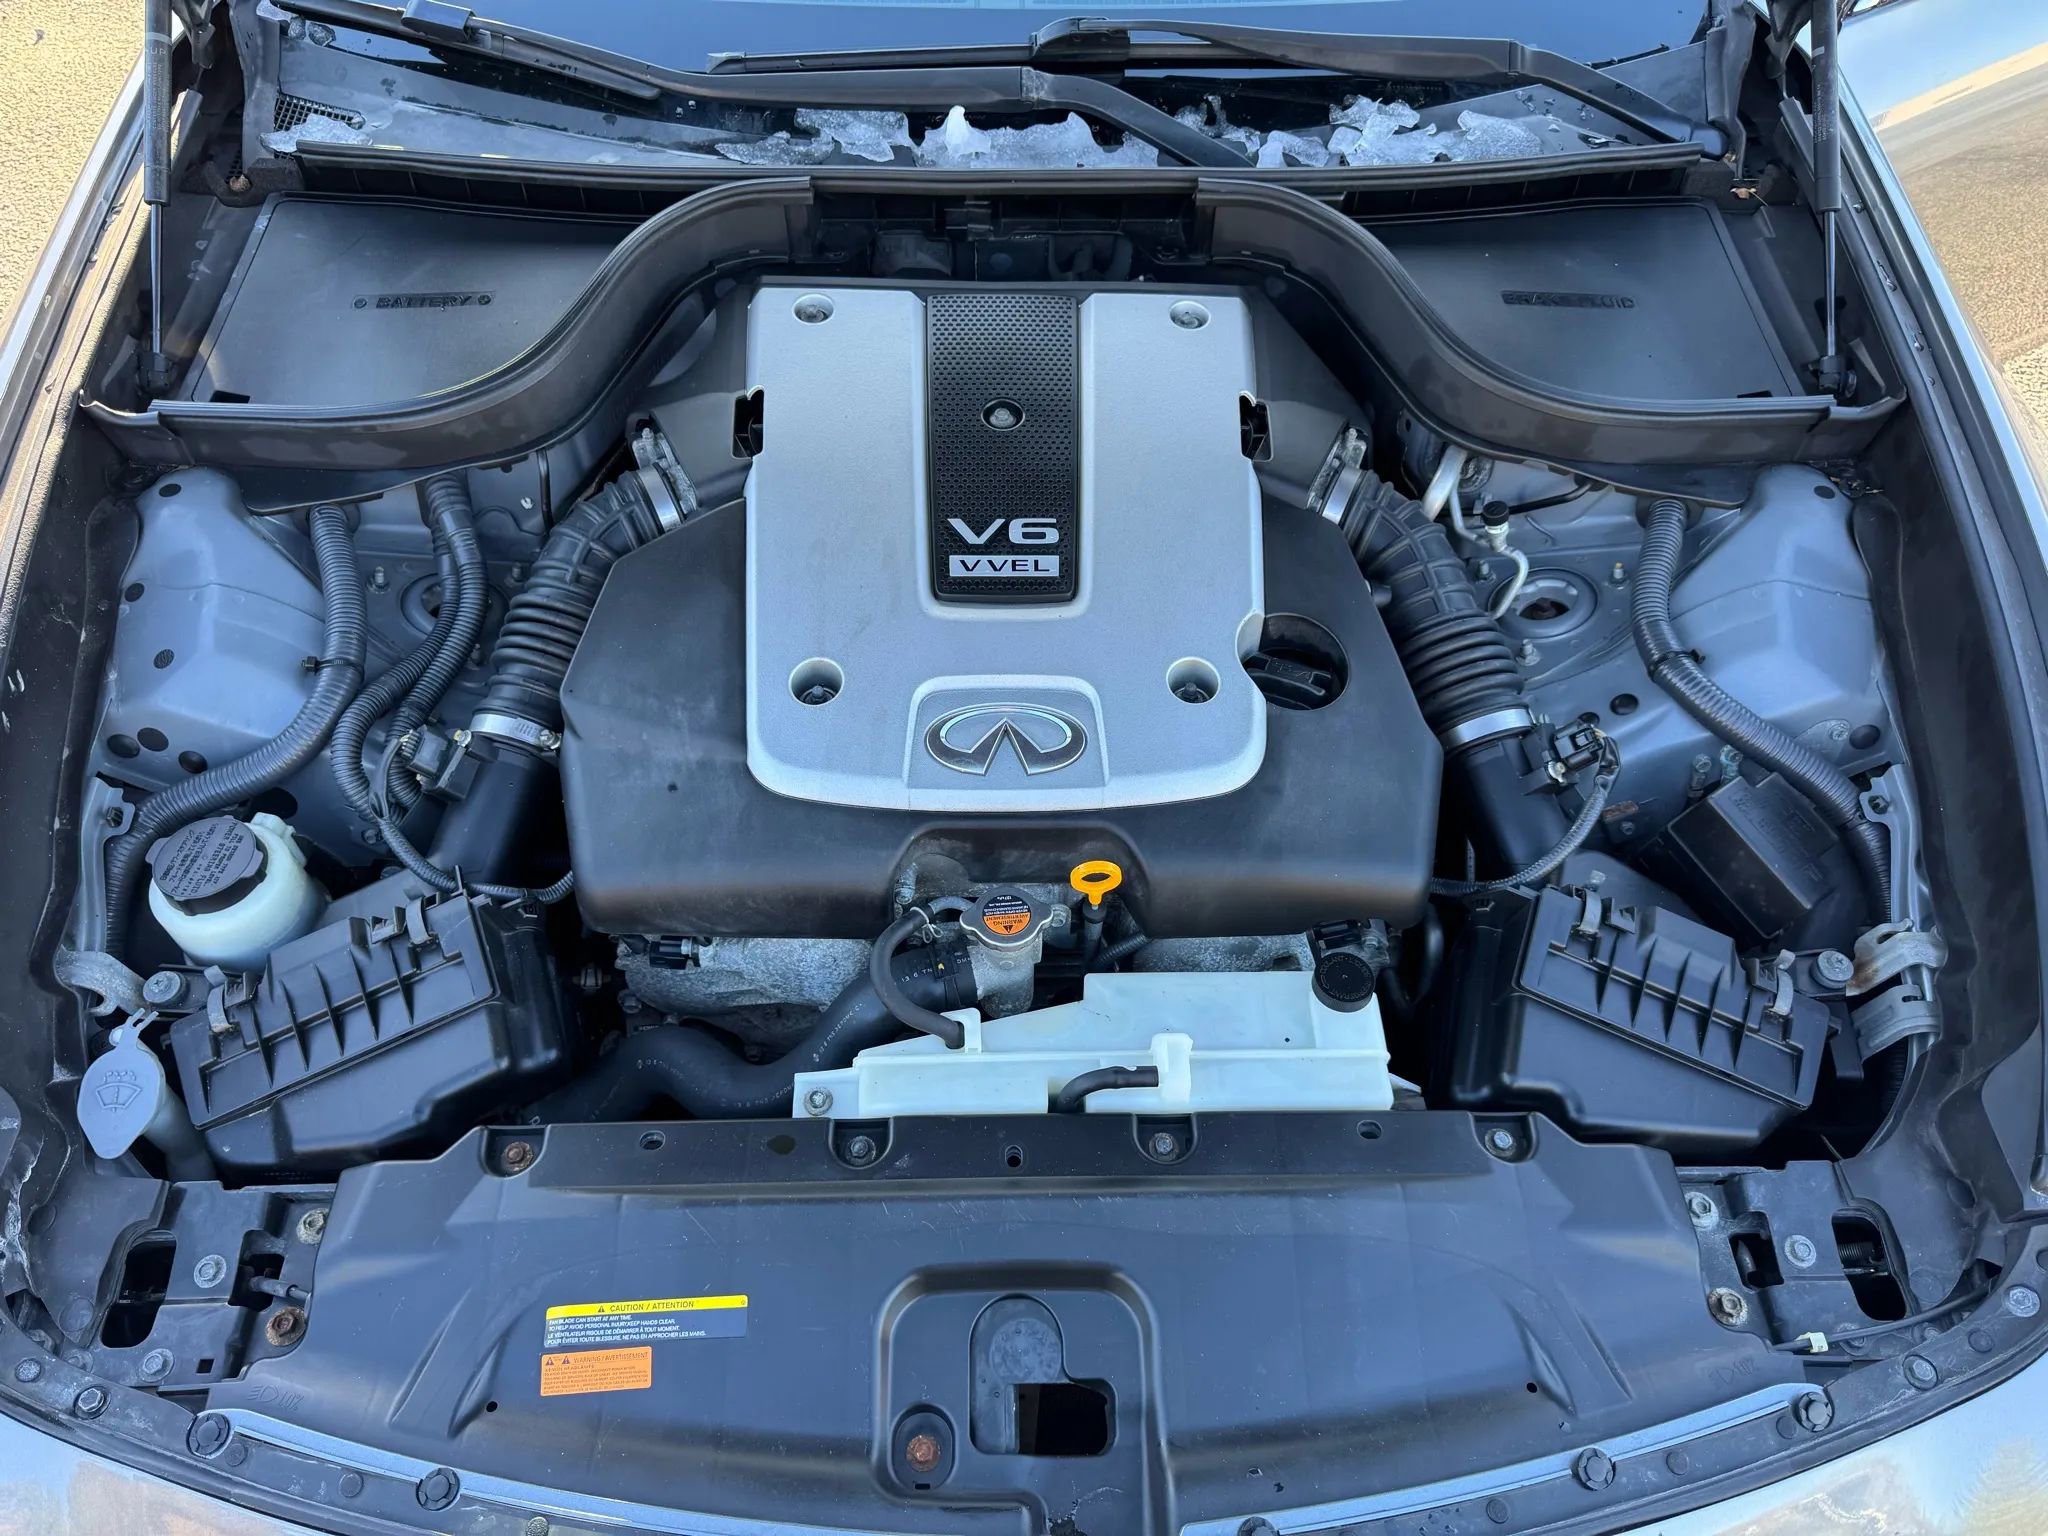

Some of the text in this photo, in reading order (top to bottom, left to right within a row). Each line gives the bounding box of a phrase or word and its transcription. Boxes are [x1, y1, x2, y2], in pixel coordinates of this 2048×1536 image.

[375, 295, 473, 309] BATTERY
[946, 518, 1060, 545] V6
[959, 559, 1050, 572] VVEL
[609, 1303, 644, 1312] CAUTION
[652, 1301, 694, 1310] ATTENTION
